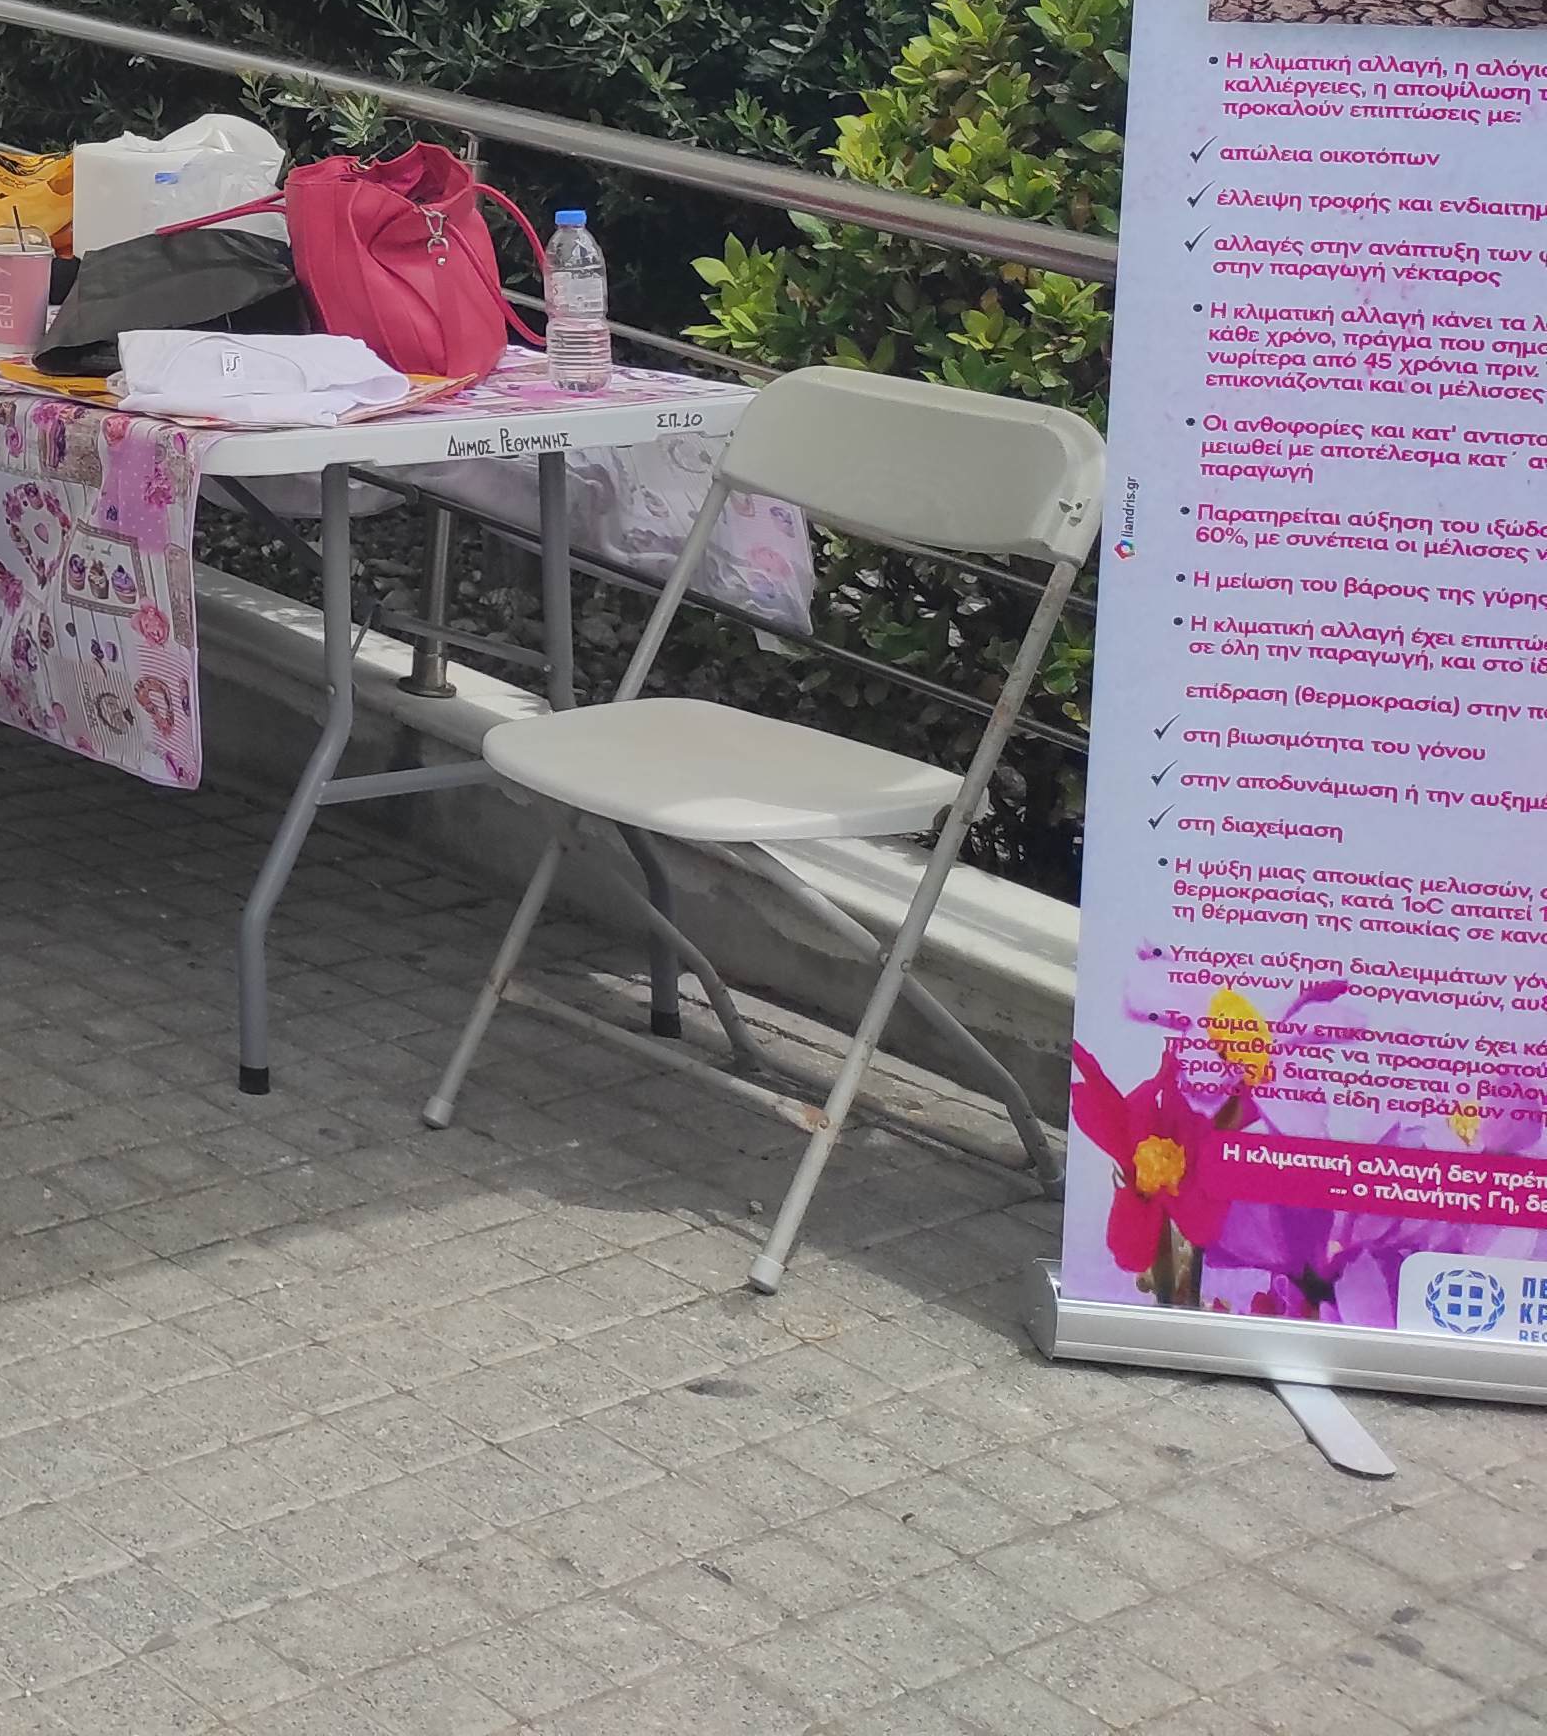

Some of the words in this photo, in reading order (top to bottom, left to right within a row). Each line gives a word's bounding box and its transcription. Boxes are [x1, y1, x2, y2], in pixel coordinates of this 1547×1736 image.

[1227, 52, 1242, 68] Η
[1250, 53, 1351, 75] κλιματική
[1358, 55, 1447, 78] αλλαγή,
[1455, 63, 1468, 79] η
[1225, 76, 1366, 98] καλλιέργειες,
[1374, 83, 1386, 99] η
[1394, 81, 1530, 107] αποψίλωση
[1223, 99, 1344, 119] προκαλούν
[1350, 103, 1481, 125] επιπτώσεις
[1488, 110, 1521, 126] με:
[1220, 145, 1313, 162] απώλεια
[1320, 147, 1440, 165] οικοτόπων
[1217, 189, 1301, 212] έλλειψη
[1308, 192, 1391, 214] τροφής
[1399, 199, 1433, 211] και
[1214, 235, 1304, 256] αλλαγές
[1311, 242, 1363, 258] στην
[1369, 240, 1479, 265] ανάπτυξη
[1487, 249, 1532, 262] των
[1213, 262, 1264, 278] στην
[1270, 262, 1385, 283] παραγωγή
[1392, 263, 1502, 287] νέκταρος
[1211, 302, 1226, 318] Η
[1234, 303, 1334, 326] κλιματική
[1341, 306, 1424, 334] αλλαγή
[1433, 311, 1492, 329] κάνει
[1499, 318, 1526, 331] τα
[1209, 325, 1259, 342] κάθε
[1265, 327, 1335, 347] χρόνο,
[1343, 330, 1432, 352] πράγμα
[1439, 338, 1484, 351] που
[1207, 349, 1306, 370] νωρίτερα
[1313, 352, 1356, 368] από
[1363, 353, 1391, 375] 45
[1398, 356, 1478, 375] χρόνια
[1485, 363, 1539, 380] πριν.
[1206, 372, 1364, 392] επικονιάζονται
[1370, 380, 1407, 393] και
[1411, 382, 1432, 394] οι
[447, 435, 495, 457] ΔΗΜΟΣ
[499, 428, 573, 453] ΡΕΘΥΜΝΗΣ
[1200, 463, 1313, 483] παραγωγή
[1178, 819, 1215, 835] στη
[1222, 816, 1342, 843] διαχείμαση
[1222, 1143, 1240, 1162] Η
[1246, 1144, 1352, 1175] κλιματική
[1358, 1154, 1443, 1183] αλλαγή
[1448, 1163, 1486, 1184] δεν
[1353, 1181, 1367, 1198] ο
[1374, 1181, 1482, 1211] πλανήτης
[1487, 1188, 1521, 1214] Γη,
